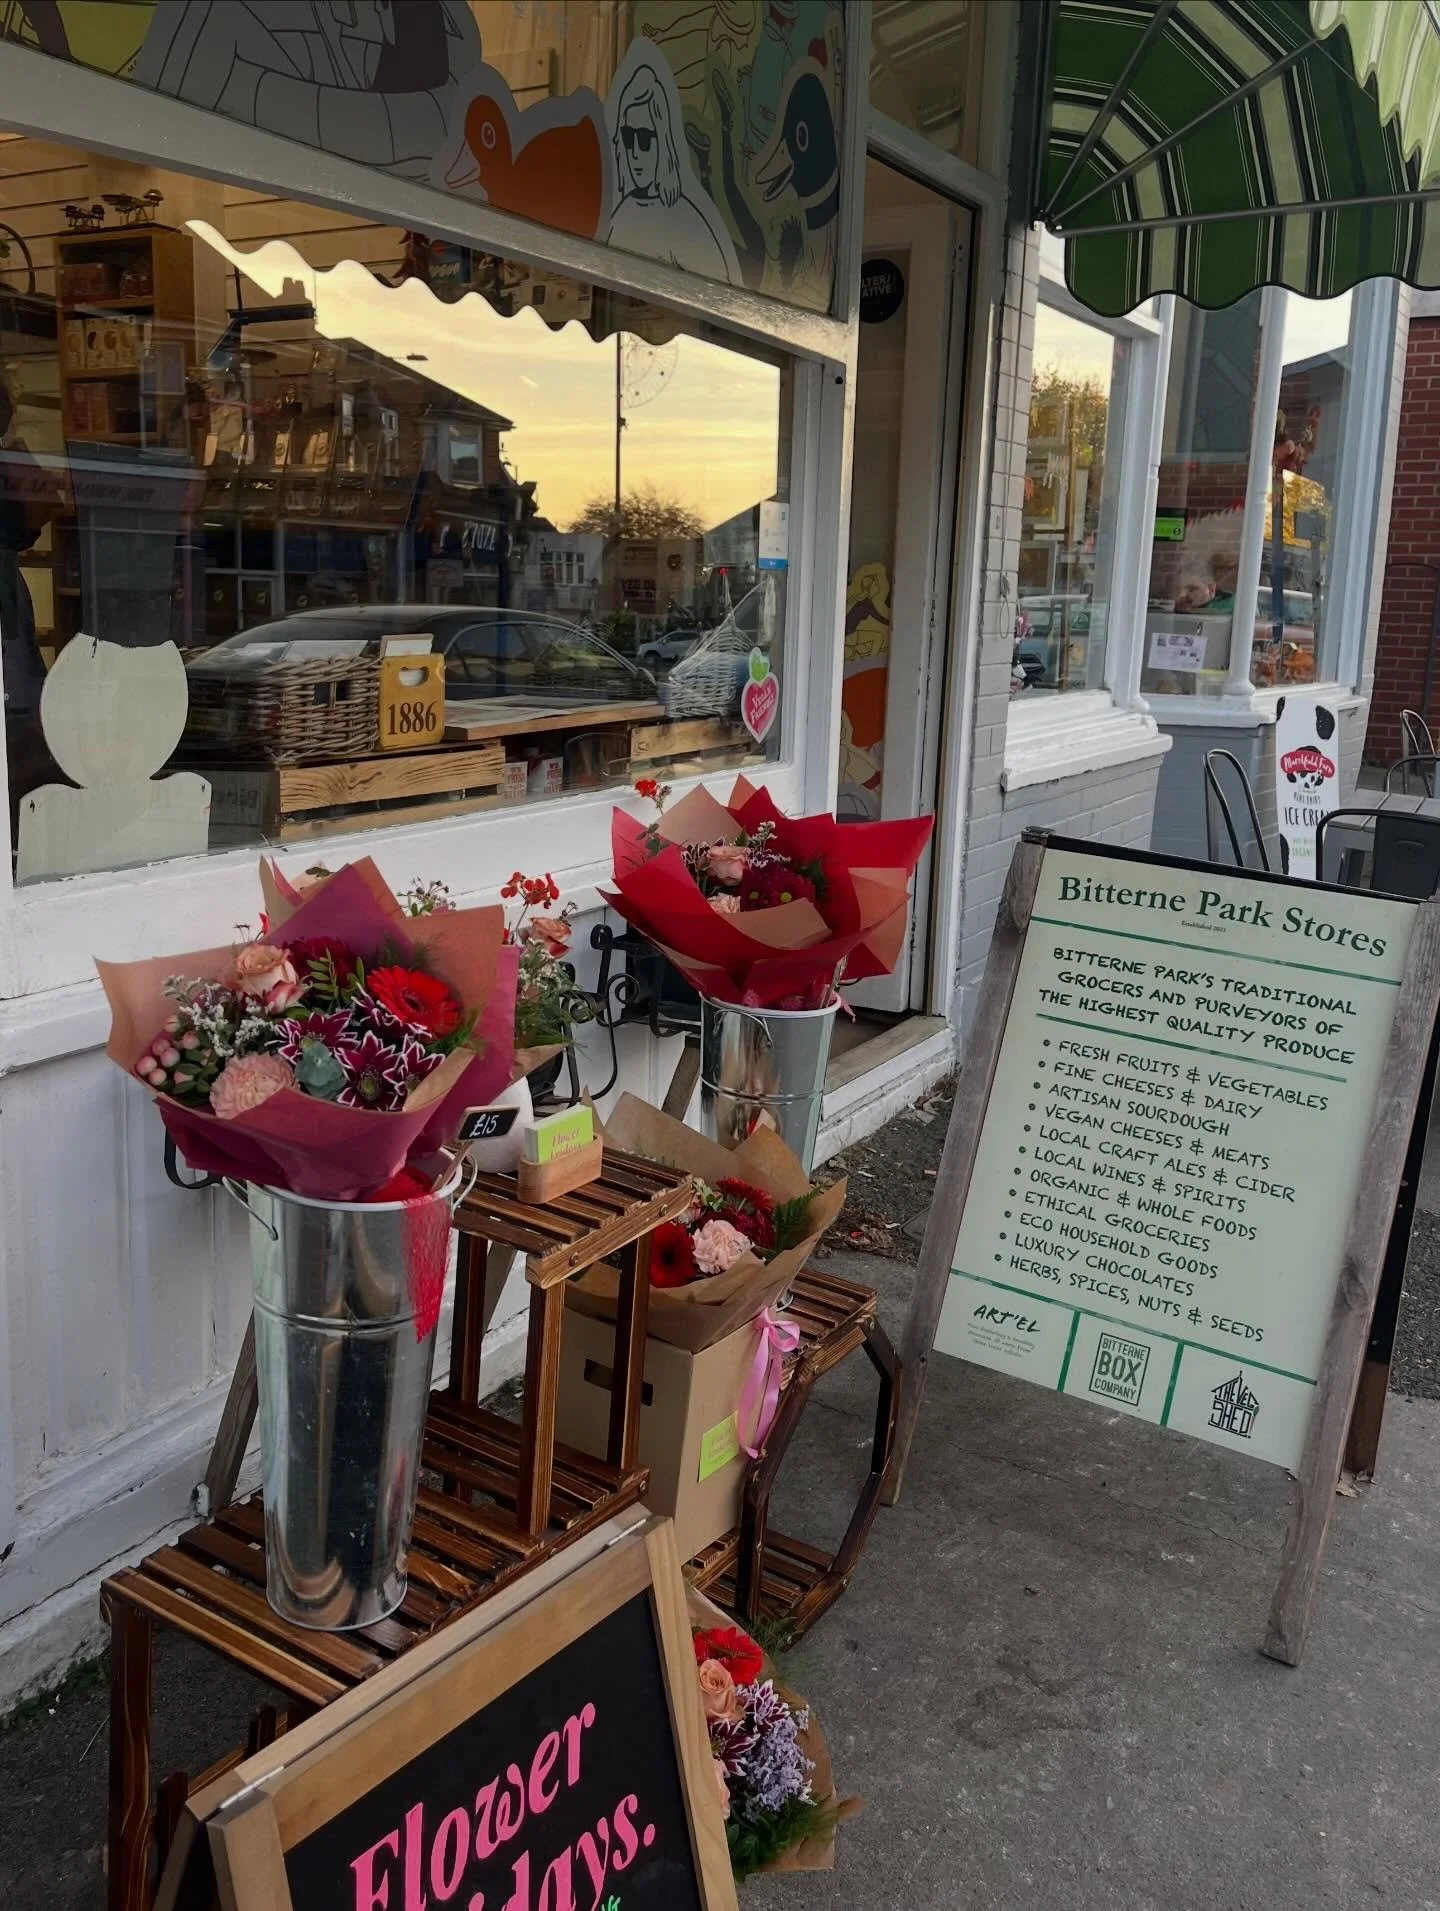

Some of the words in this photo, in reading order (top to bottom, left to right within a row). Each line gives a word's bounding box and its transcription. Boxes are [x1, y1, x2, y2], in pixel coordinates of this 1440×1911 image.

[387, 701, 437, 735] 1886
[1284, 806, 1301, 826] ICE
[1302, 807, 1332, 827] CREA
[1057, 876, 1186, 912] Bitterne
[1195, 890, 1273, 928] Park
[1282, 907, 1387, 957] Stores
[1053, 947, 1148, 975] BITTERNE
[1153, 965, 1215, 989] PARK'S
[1221, 978, 1357, 1016] TRADITIONAL
[1057, 971, 1144, 998] GROCERS
[1148, 989, 1186, 1006] AND
[1194, 996, 1307, 1031] PURVEYORS
[1315, 1020, 1344, 1036] OF
[1038, 988, 1073, 1007] THE
[1078, 996, 1160, 1024] HIGHEST
[1166, 1015, 1256, 1043] QUALITY
[1263, 1034, 1356, 1065] PRODUCE
[1054, 1061, 1097, 1082] FINE
[1102, 1073, 1175, 1100] CHEESES
[1180, 1089, 1195, 1107] &
[1204, 1095, 1264, 1119] DAIRY
[1059, 1040, 1110, 1062] FRESH
[1116, 1053, 1180, 1078] FRUITS
[1186, 1066, 1201, 1085] &
[1208, 1071, 1329, 1111] VEGETABLES
[469, 1113, 500, 1138] £15
[1045, 1104, 1105, 1130] VEGAN
[1110, 1121, 1184, 1149] CHEESES
[1189, 1138, 1204, 1156] &
[1211, 1145, 1270, 1170] MEATS
[1048, 1083, 1121, 1111] ARTISAN
[1127, 1101, 1230, 1137] SOURDOUGH
[1034, 1146, 1086, 1172] LOCAL
[1092, 1162, 1146, 1187] WINES
[1151, 1176, 1166, 1194] &
[1174, 1183, 1246, 1213] SPIRITS
[1039, 1124, 1091, 1150] LOCAL
[1098, 1141, 1159, 1166] CRAFT
[1163, 1158, 1207, 1179] ALES
[1212, 1168, 1228, 1186] &
[1235, 1175, 1295, 1203] CIDER
[1024, 1190, 1097, 1222] ETHICAL
[1104, 1213, 1210, 1252] GROCERIES
[1030, 1169, 1110, 1201] ORGANIC
[1116, 1191, 1131, 1209] &
[1137, 1196, 1196, 1224] WHOLE
[1201, 1215, 1257, 1241] FOODS
[1015, 1233, 1080, 1262] LUXURY
[1085, 1255, 1195, 1297] CHOCOLATES
[1019, 1212, 1053, 1232] ECO
[1059, 1222, 1150, 1259] HOUSEHOLD
[1157, 1252, 1218, 1279] GOODS
[973, 1304, 1040, 1332] ART'EL
[1010, 1255, 1061, 1285] HERBS,
[1069, 1273, 1130, 1305] SPICES,
[1138, 1294, 1182, 1317] NUTS
[1187, 1307, 1203, 1326] &
[1210, 1315, 1264, 1342] SEEDS
[1098, 1352, 1143, 1387] BOX
[1102, 1337, 1146, 1361] BITTERNE
[1094, 1378, 1137, 1401] COMPANY
[349, 1702, 597, 1911] Flower
